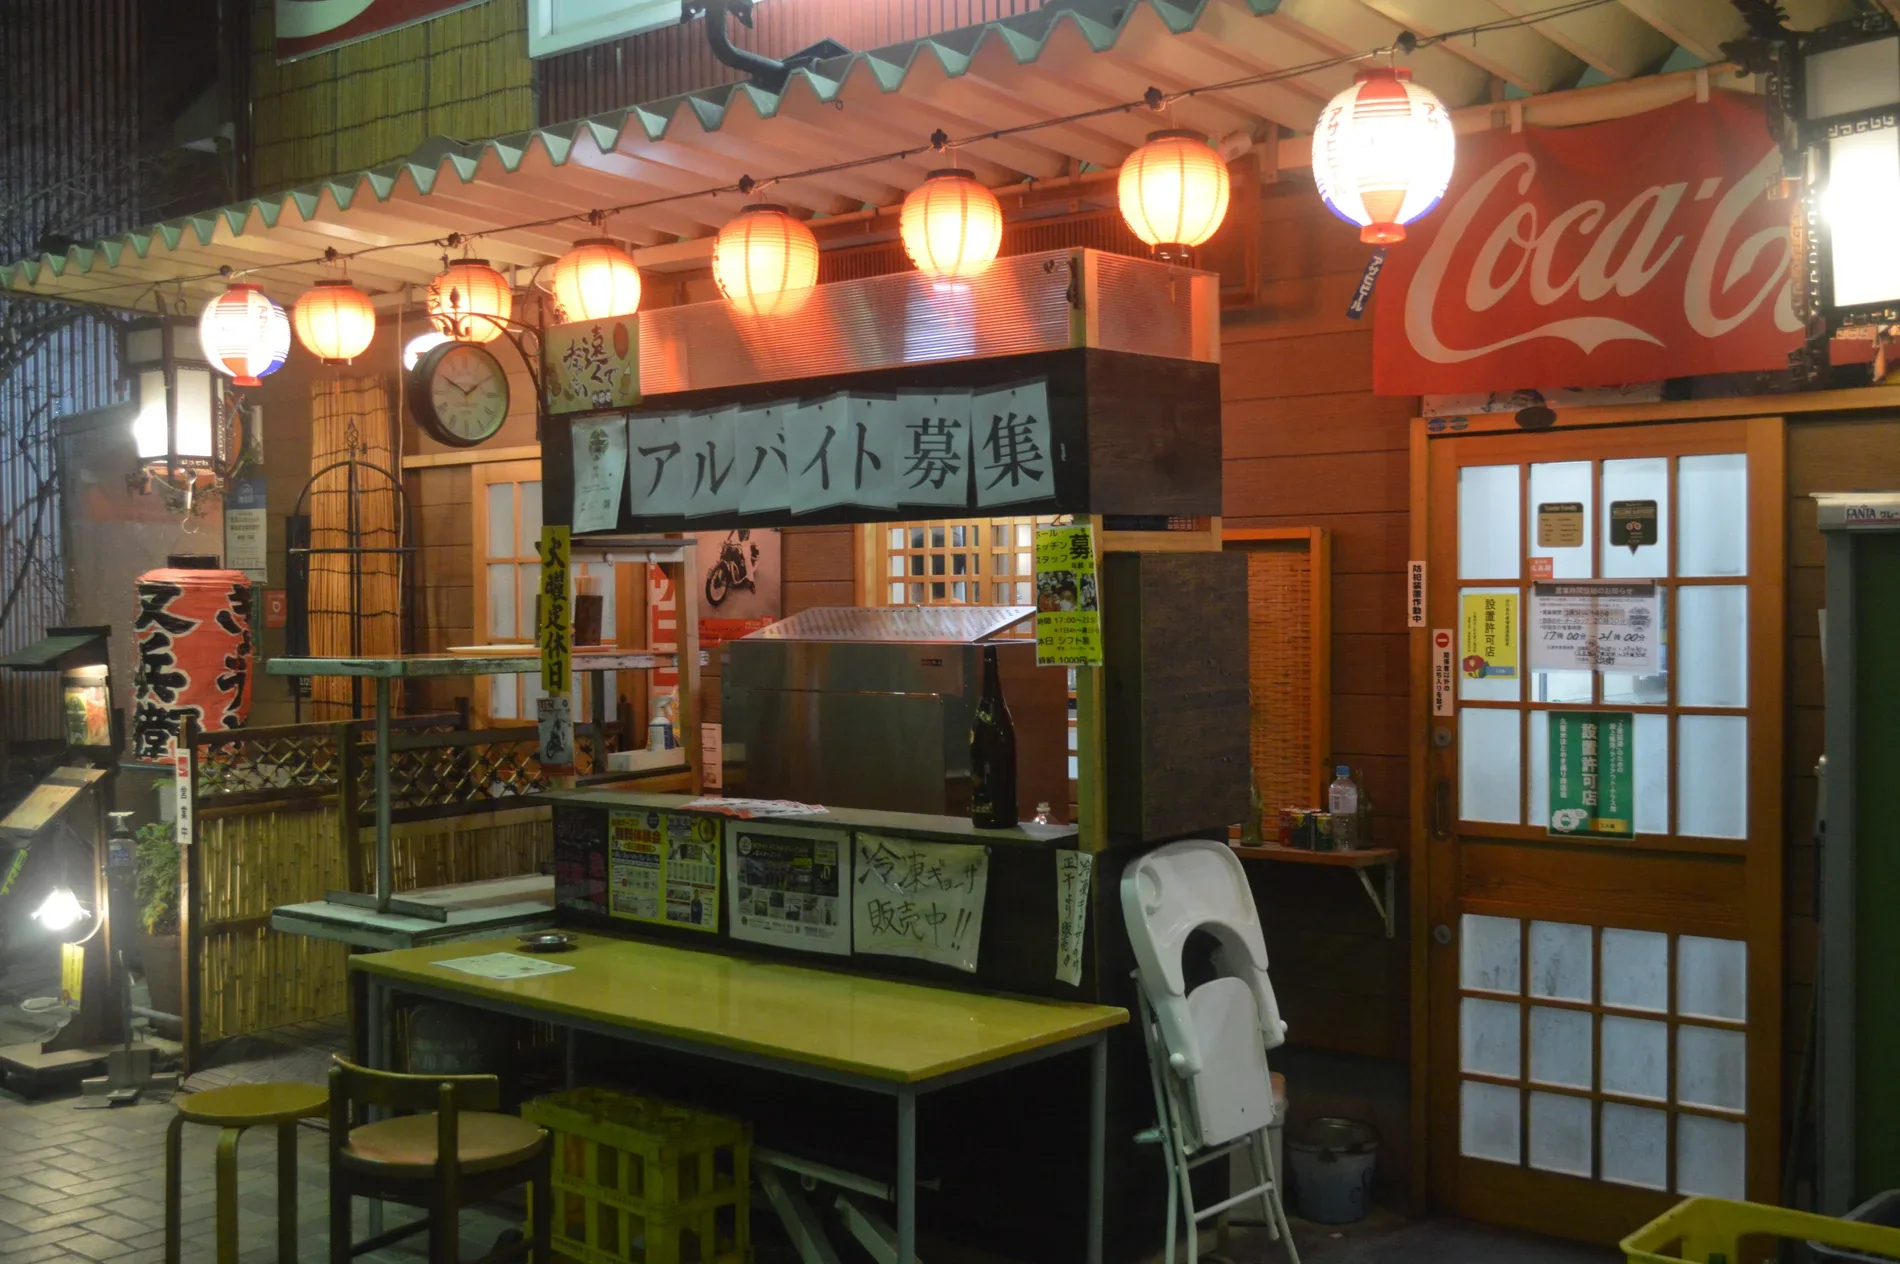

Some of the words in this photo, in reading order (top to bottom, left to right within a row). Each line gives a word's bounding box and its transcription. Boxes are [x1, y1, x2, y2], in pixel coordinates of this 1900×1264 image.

[636, 411, 1045, 499] アルバイト募集
[1846, 508, 1876, 519] FANTA
[544, 536, 568, 691] 火曜定休日
[1412, 564, 1422, 623] 防犯装置作動中
[1485, 598, 1496, 657] 設置許可店
[134, 584, 204, 759] 又兵衛
[1581, 723, 1597, 806] 設置許可店
[180, 785, 188, 840] 営業中
